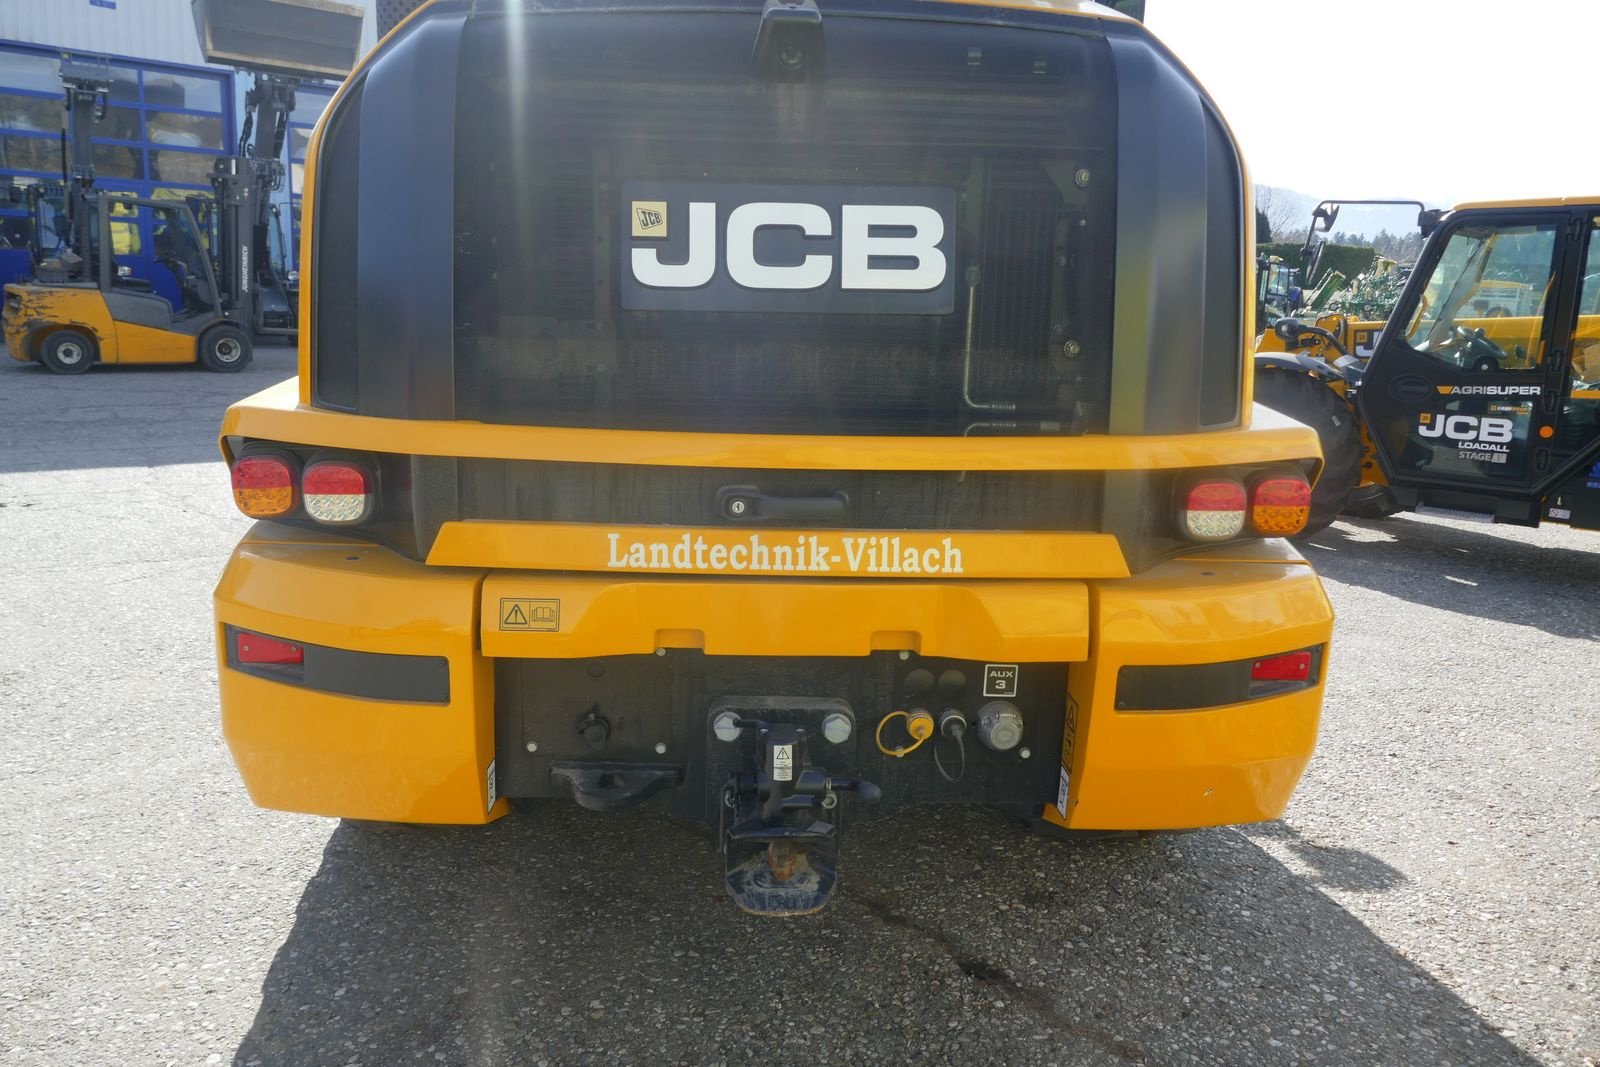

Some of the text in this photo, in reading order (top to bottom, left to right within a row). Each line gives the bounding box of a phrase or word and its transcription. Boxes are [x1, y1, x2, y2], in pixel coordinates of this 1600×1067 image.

[641, 210, 661, 227] JCB
[631, 201, 947, 289] JCB
[241, 245, 249, 293] JUNGHEINRICH
[1450, 385, 1541, 396] AGRISUPER
[1418, 414, 1513, 443] JCB
[1458, 441, 1510, 452] LOADALL
[1458, 451, 1491, 462] STAGE
[607, 532, 964, 575] Landtechnik-Villach
[989, 670, 1013, 678] AUX
[995, 680, 1006, 689] 3
